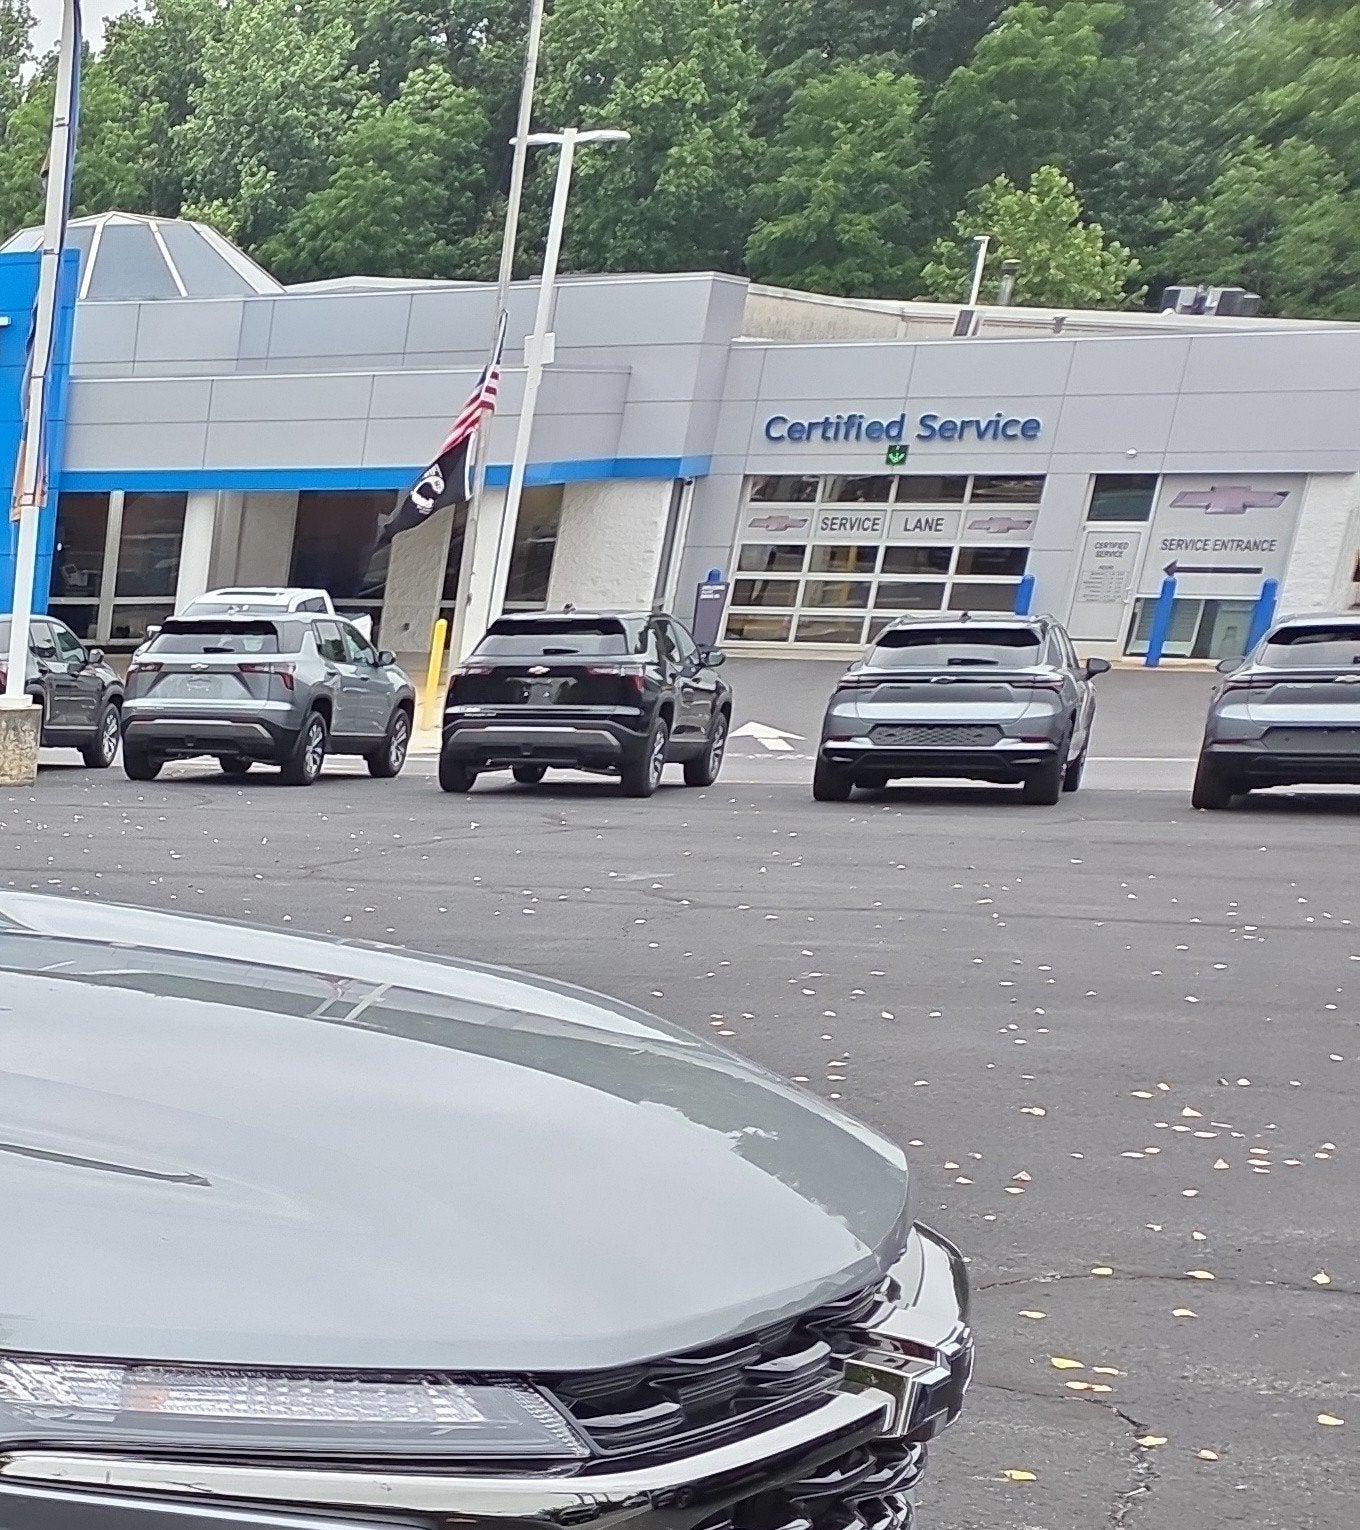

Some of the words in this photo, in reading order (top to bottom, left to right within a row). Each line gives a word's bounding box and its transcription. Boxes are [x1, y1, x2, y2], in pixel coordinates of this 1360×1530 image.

[765, 412, 907, 442] Certified
[915, 412, 1042, 442] Service
[820, 516, 882, 532] SERVICE
[903, 516, 945, 533] LANE
[1161, 538, 1211, 552] SERVICE
[1212, 538, 1278, 552] ENTRANCE
